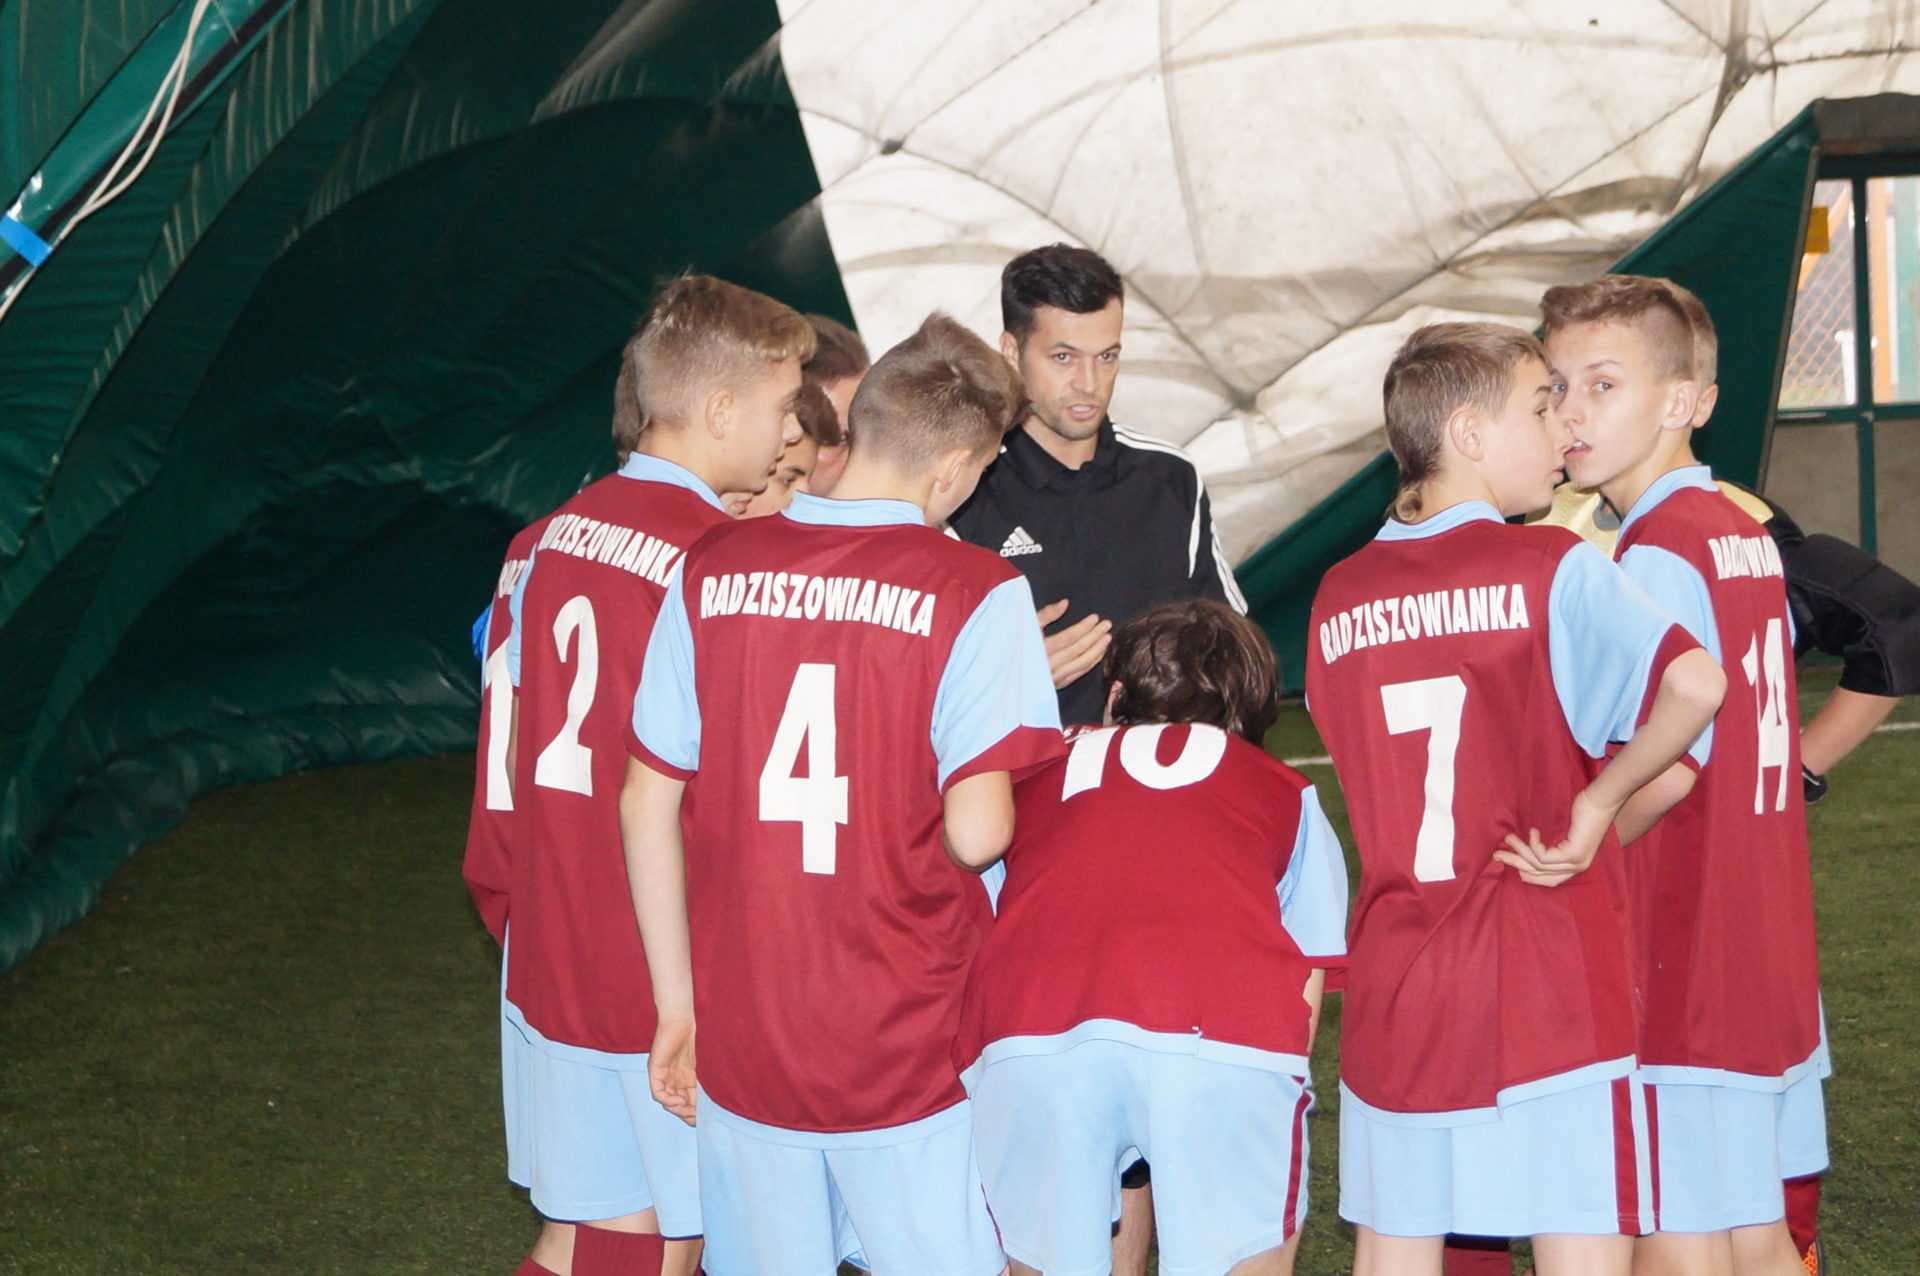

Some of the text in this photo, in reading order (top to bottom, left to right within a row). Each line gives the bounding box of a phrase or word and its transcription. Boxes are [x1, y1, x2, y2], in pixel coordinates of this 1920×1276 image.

[534, 595, 598, 797] 2
[701, 572, 936, 637] RADZISZOWIANKA
[1320, 584, 1529, 664] RADZISZOWIANKA
[759, 663, 848, 875] 4
[1380, 675, 1467, 882] 7
[1741, 618, 1789, 815] 14
